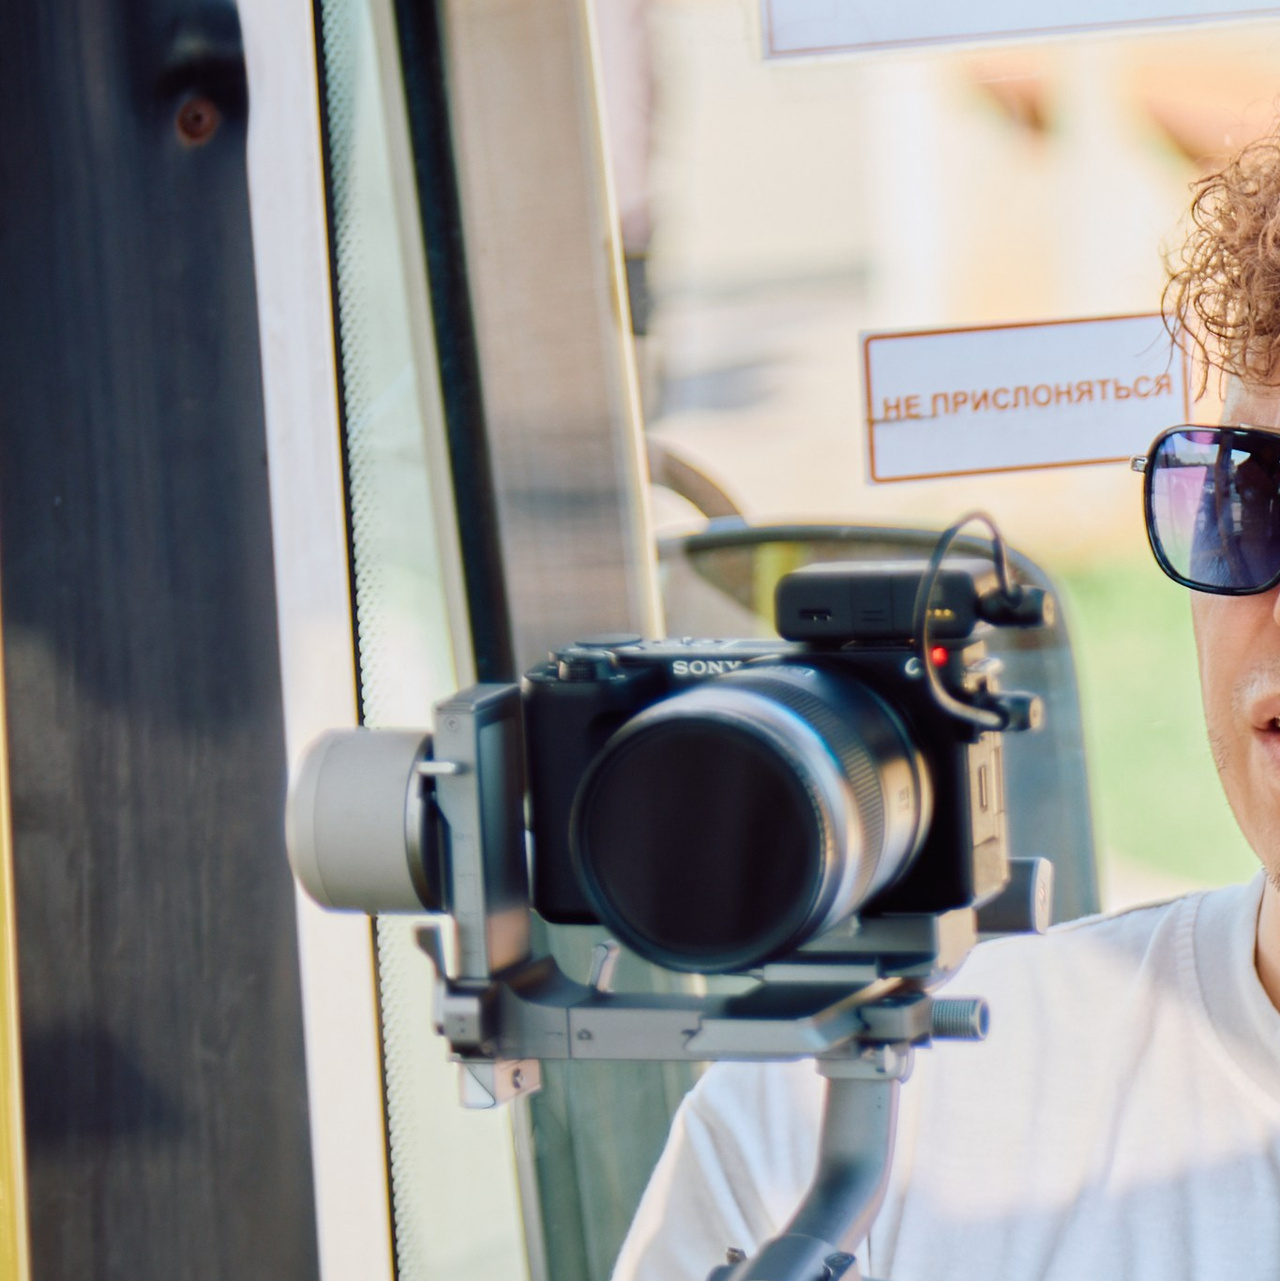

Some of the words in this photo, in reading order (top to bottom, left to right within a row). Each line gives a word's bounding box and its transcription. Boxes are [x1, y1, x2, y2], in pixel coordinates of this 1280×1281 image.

[882, 394, 921, 420] НЕ
[931, 372, 1172, 418] ПРИСЛОНЯТЬСЯ
[672, 660, 743, 675] SONY
